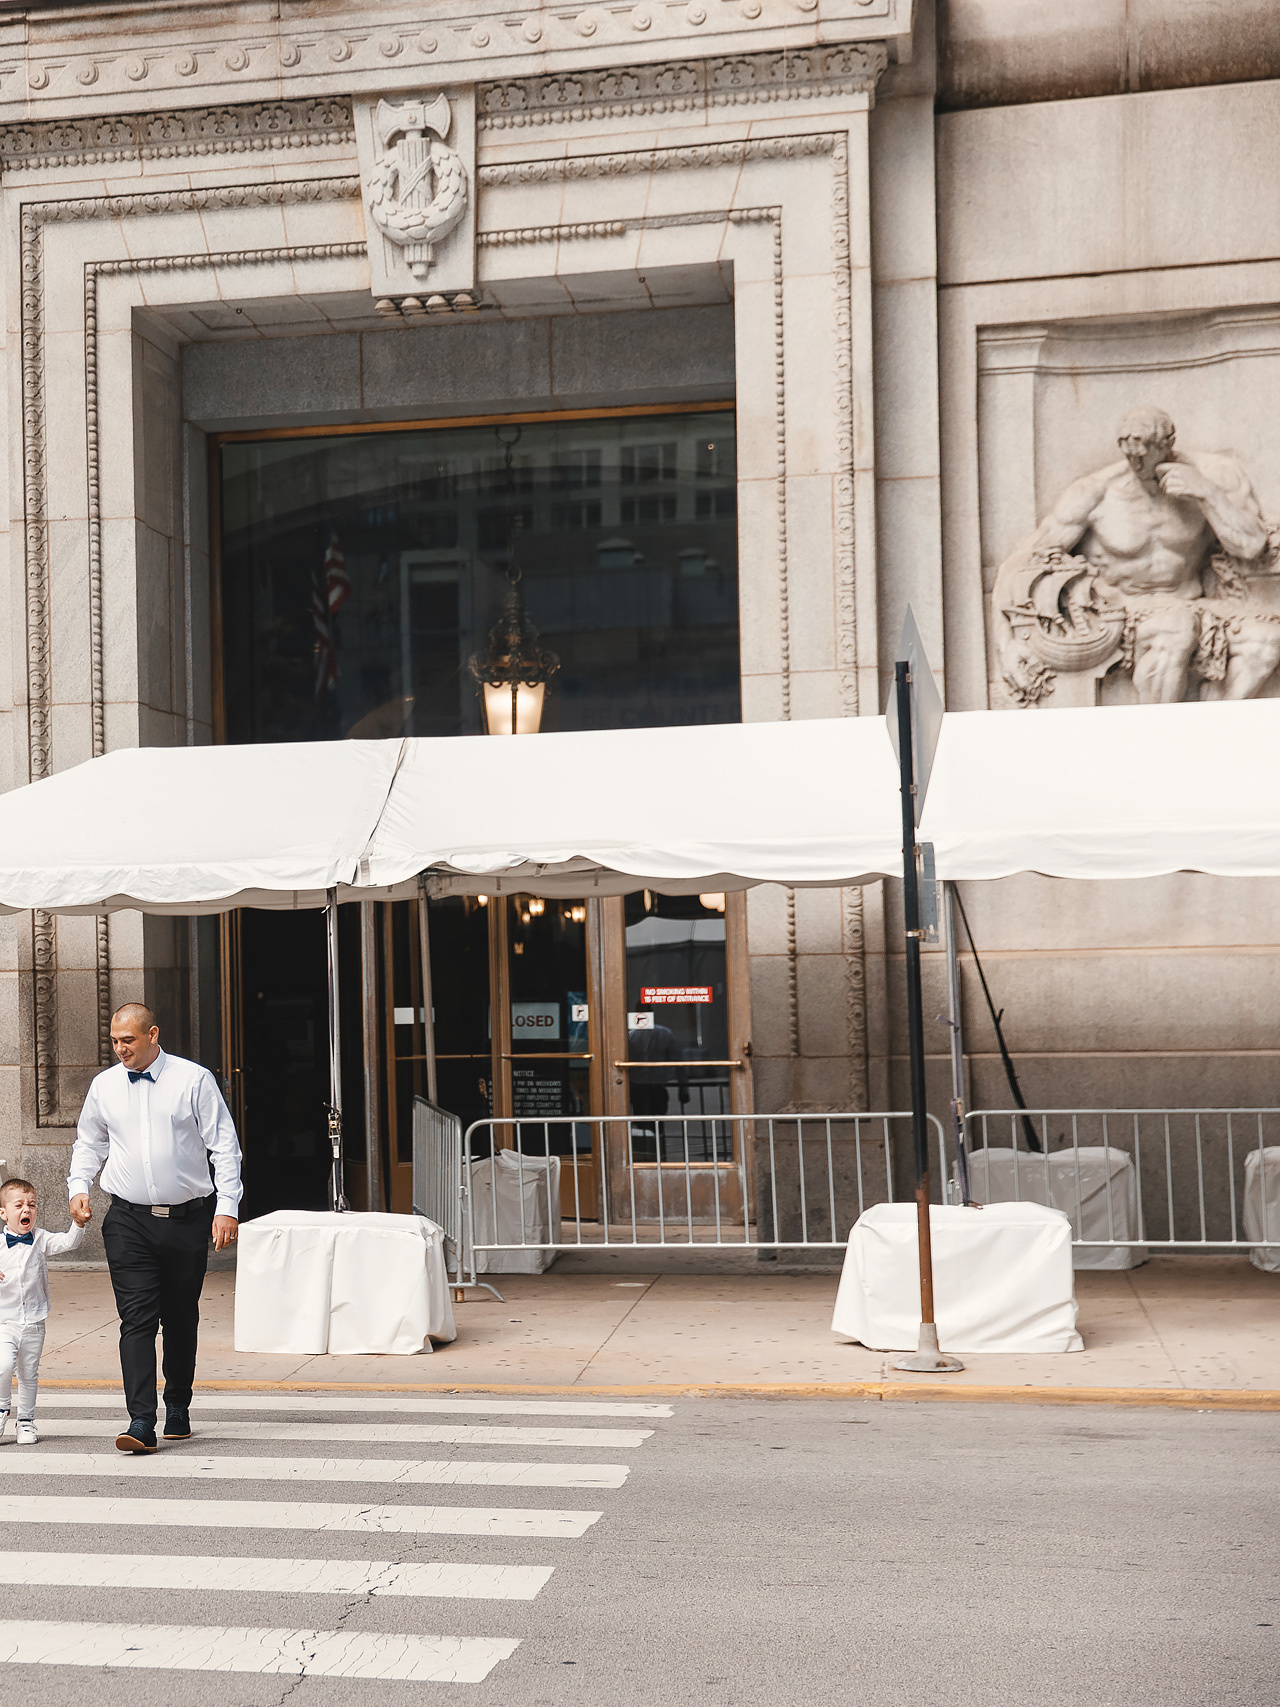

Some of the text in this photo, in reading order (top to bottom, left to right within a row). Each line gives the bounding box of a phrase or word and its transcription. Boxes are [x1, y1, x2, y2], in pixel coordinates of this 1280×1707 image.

[656, 987, 685, 995] SMOKING
[685, 987, 708, 995] WITHIN
[652, 995, 666, 1003] FEET
[512, 1015, 555, 1027] OSED
